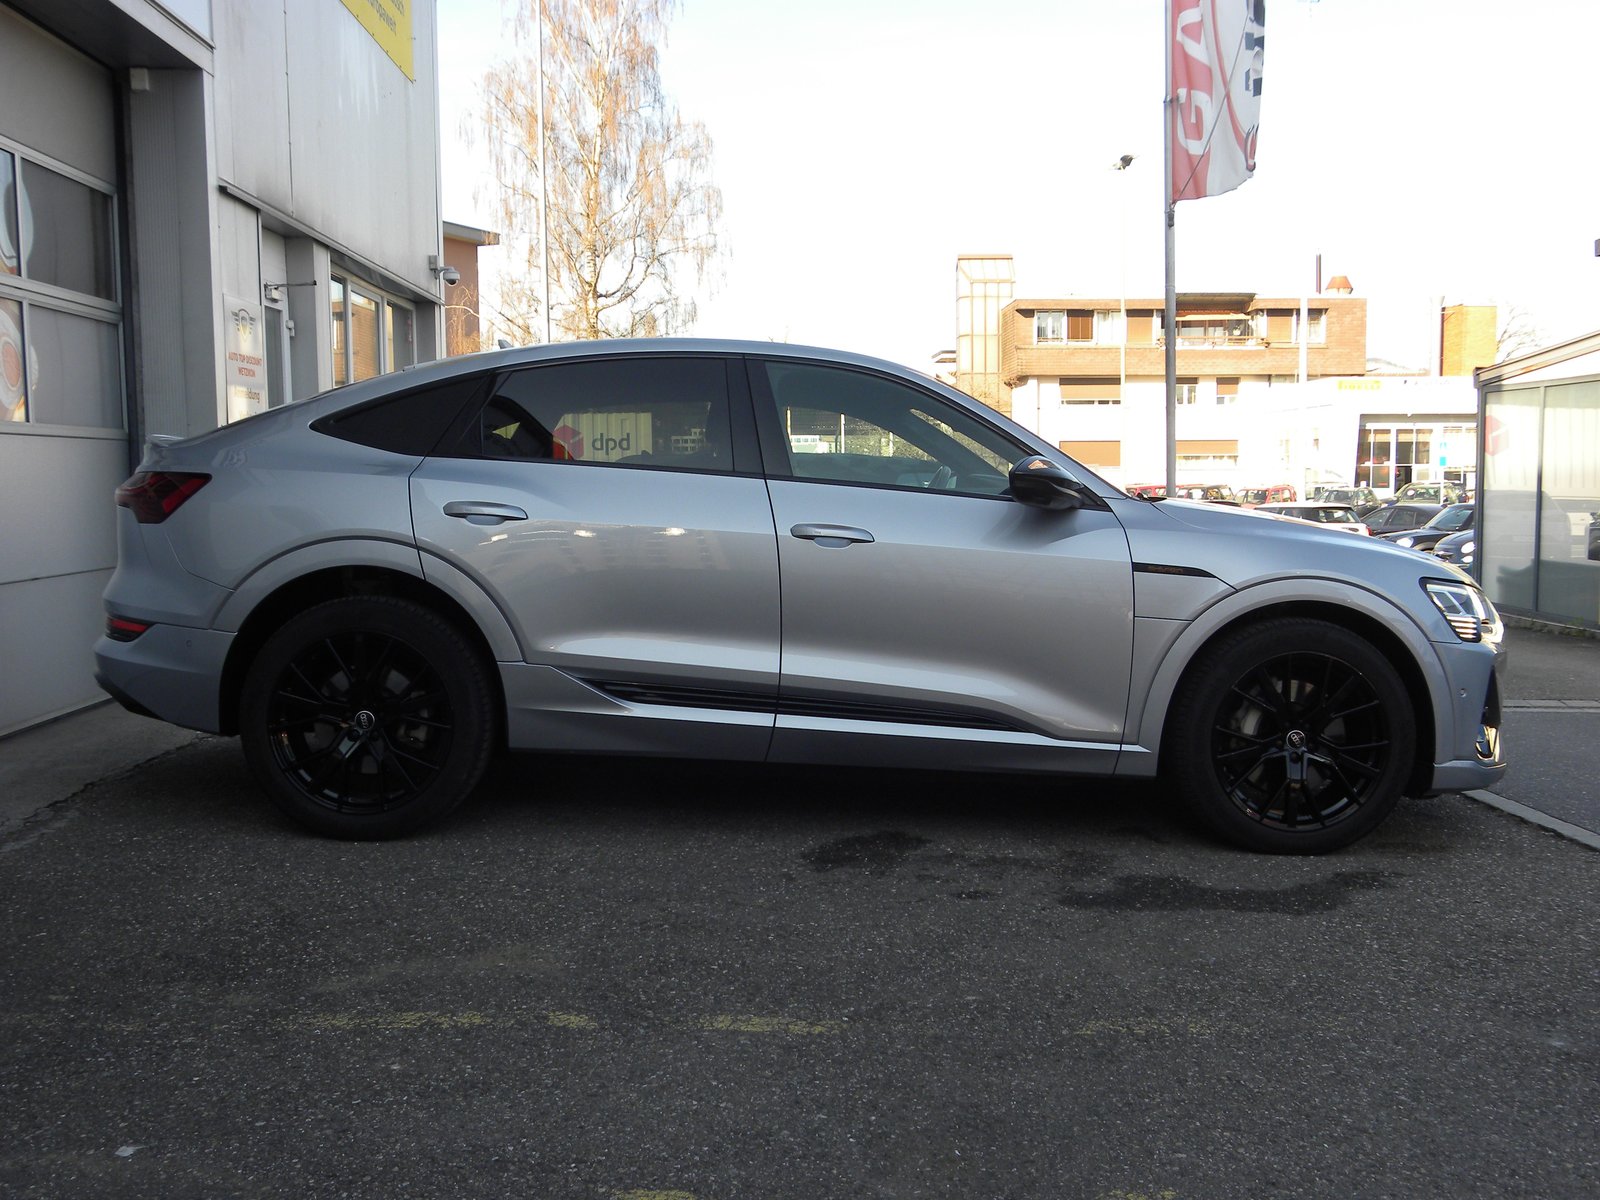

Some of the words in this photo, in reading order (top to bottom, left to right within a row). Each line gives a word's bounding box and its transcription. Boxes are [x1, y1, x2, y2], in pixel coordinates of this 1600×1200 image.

[228, 352, 239, 362] AUTO
[239, 354, 247, 363] TOP
[246, 356, 262, 366] DISCOUNT
[592, 432, 631, 456] dpd
